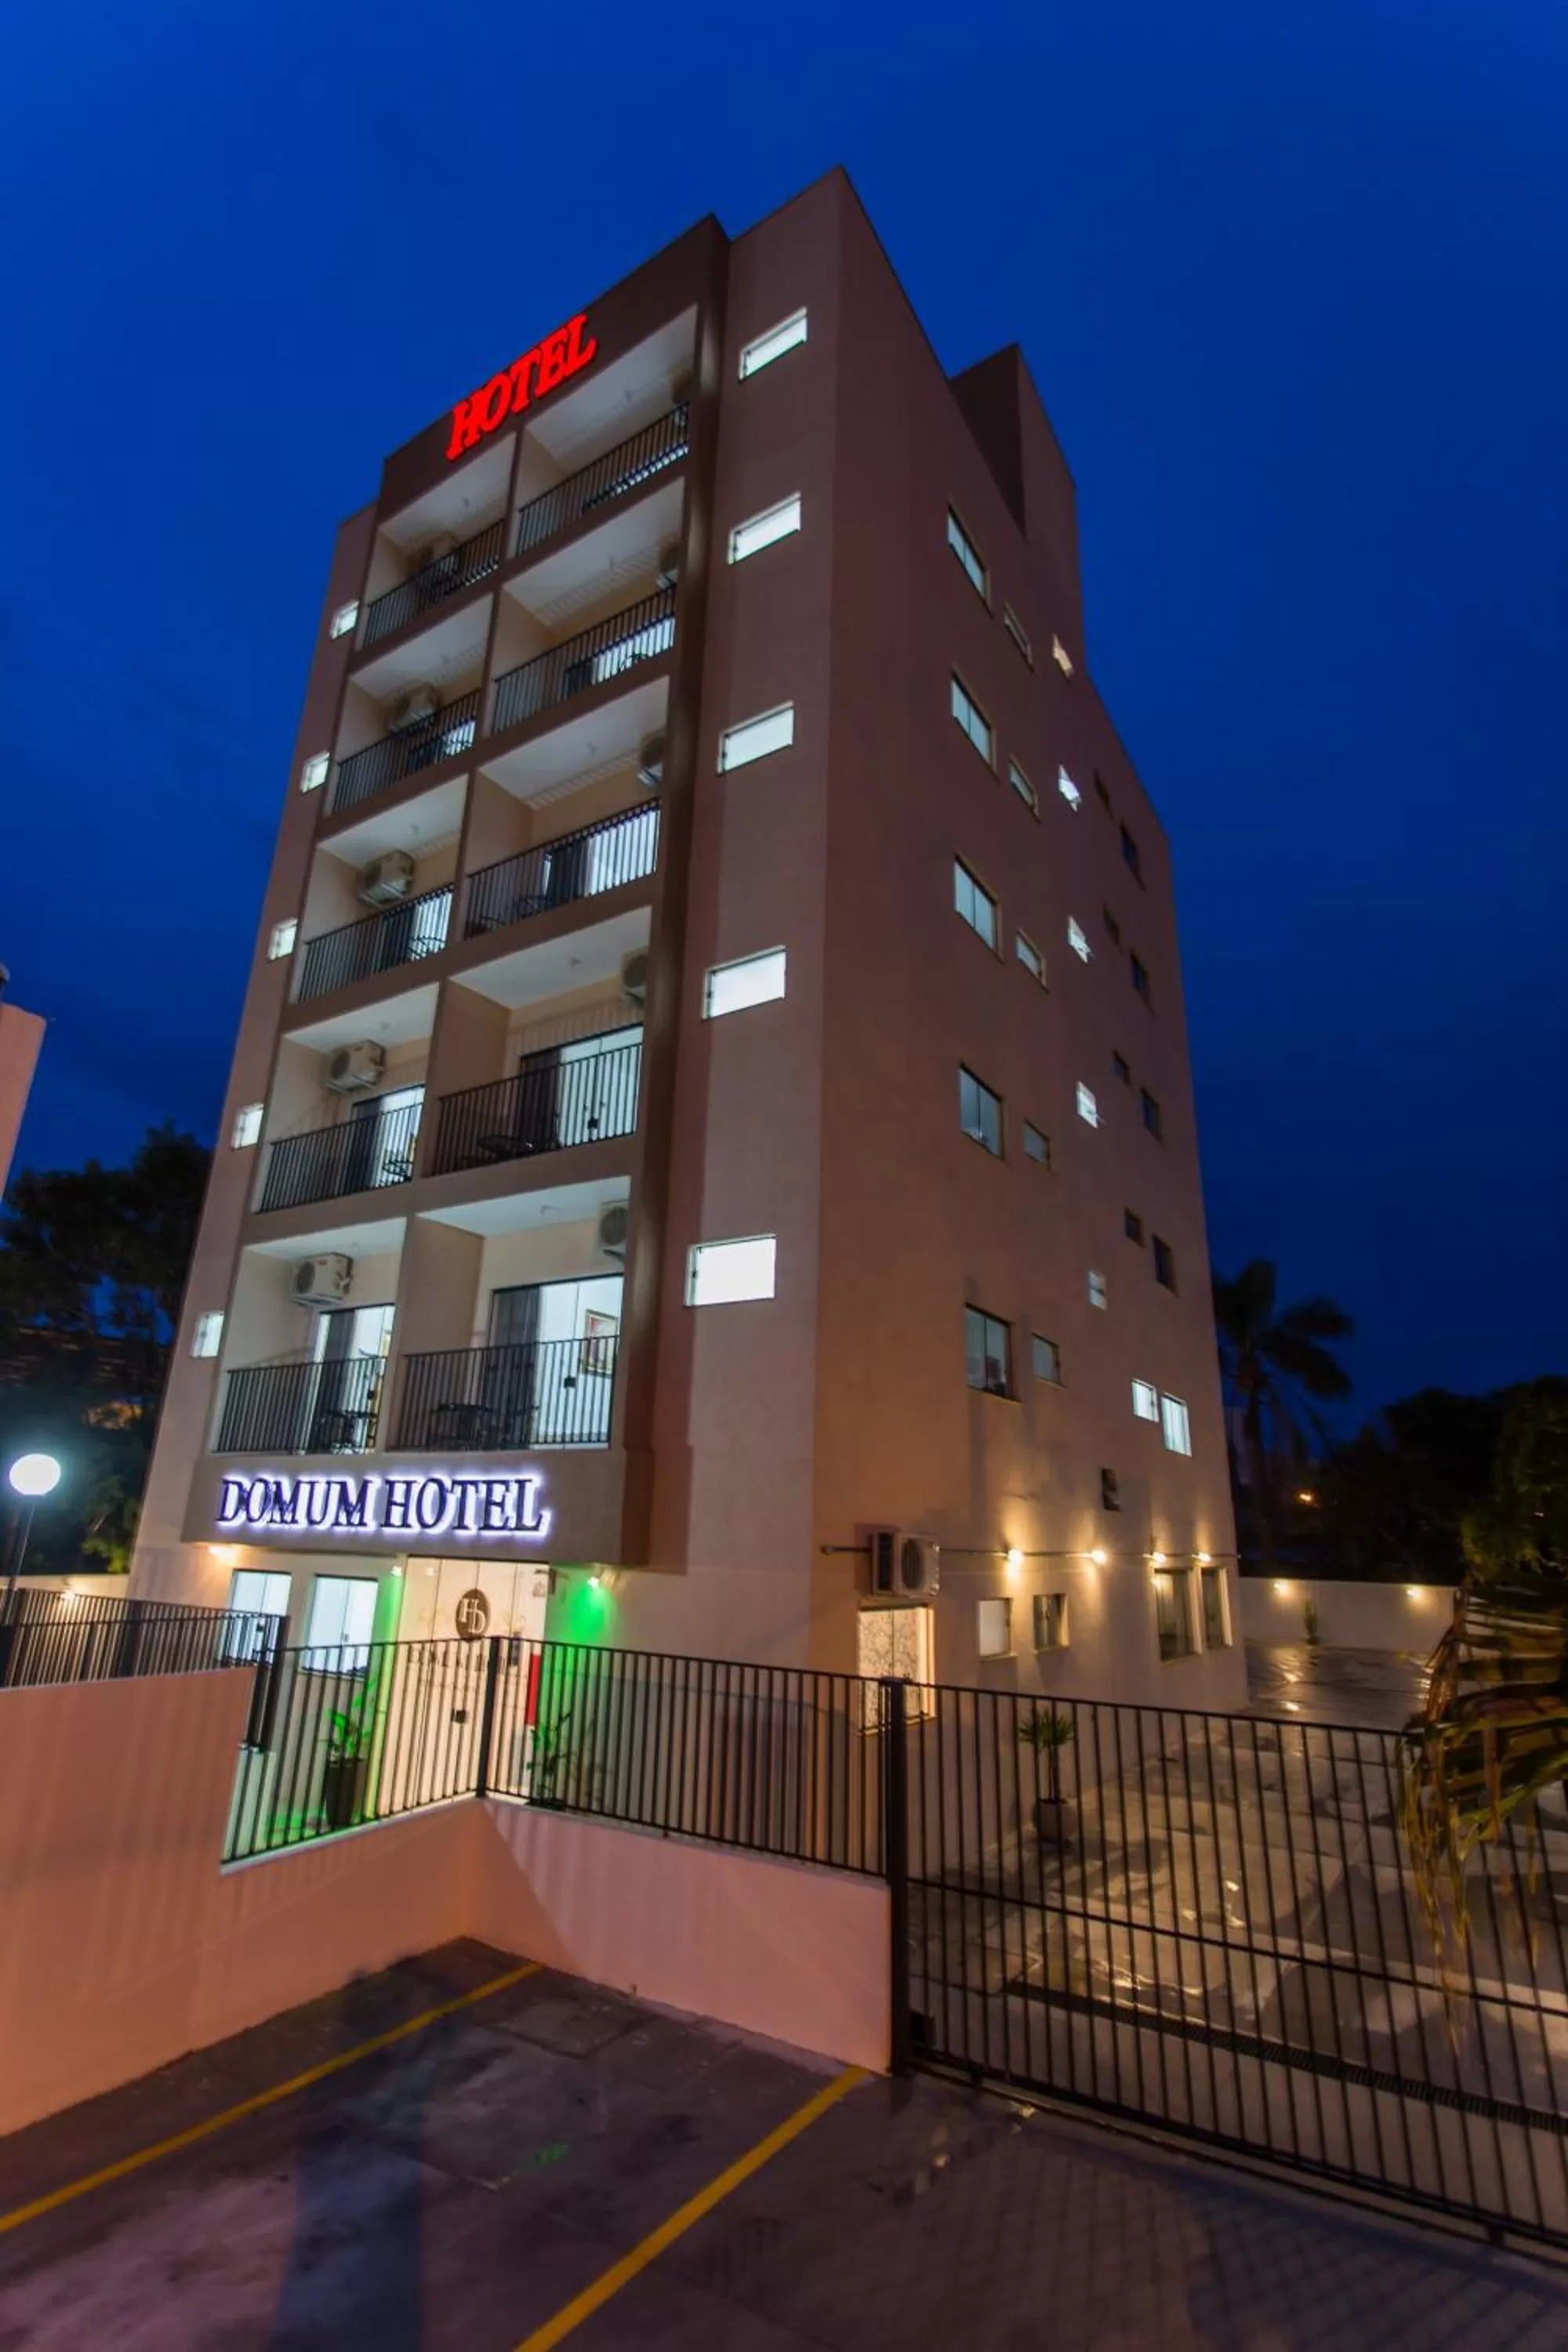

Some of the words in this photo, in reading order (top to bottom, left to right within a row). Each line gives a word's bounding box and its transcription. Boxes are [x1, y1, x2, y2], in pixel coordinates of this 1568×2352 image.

[445, 314, 596, 459] HOTEL
[216, 1479, 372, 1526] DOMUM
[381, 1477, 545, 1532] HOTEL
